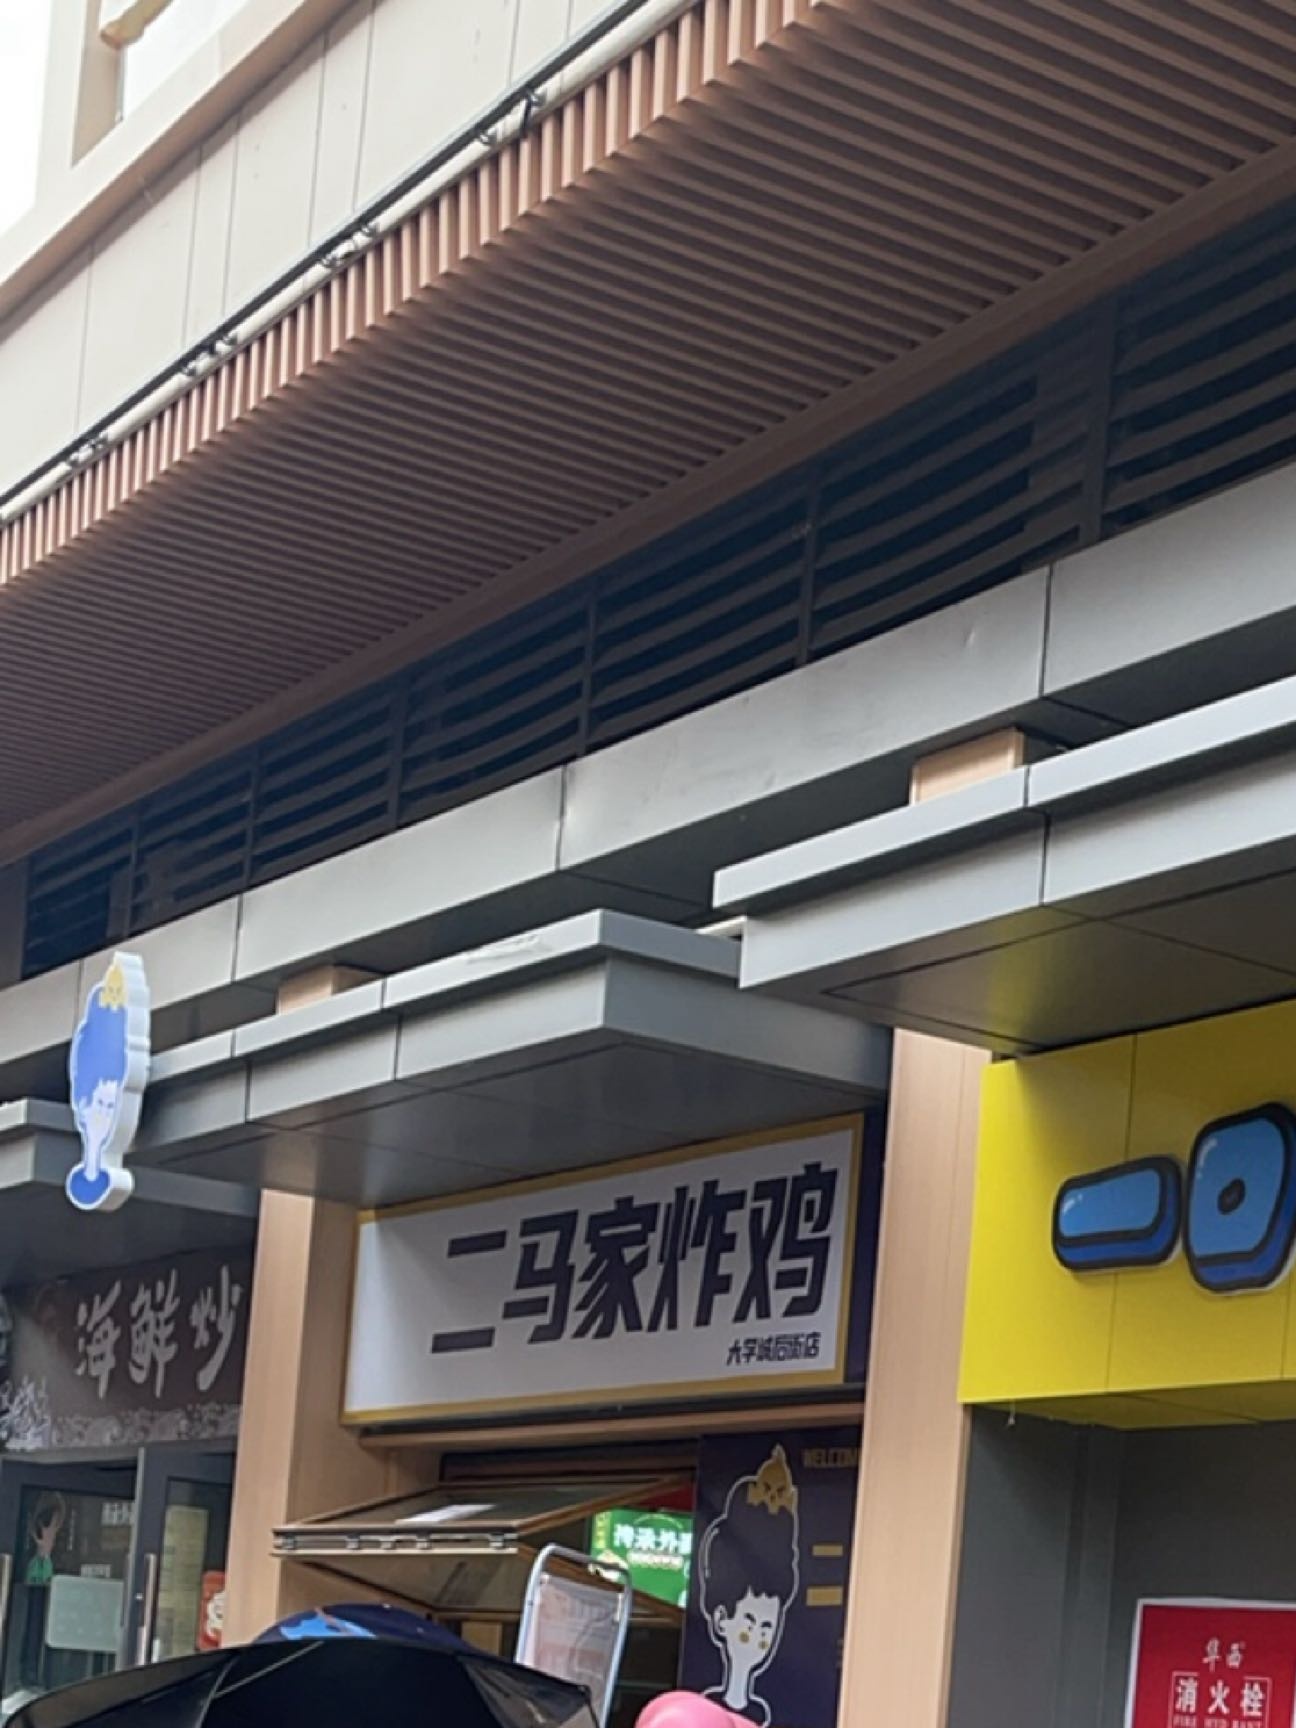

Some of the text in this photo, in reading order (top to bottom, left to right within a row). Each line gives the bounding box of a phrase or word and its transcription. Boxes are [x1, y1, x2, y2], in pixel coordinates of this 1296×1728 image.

[431, 1161, 839, 1354] 二马家炸鸡
[1175, 1677, 1265, 1717] 消火栓
